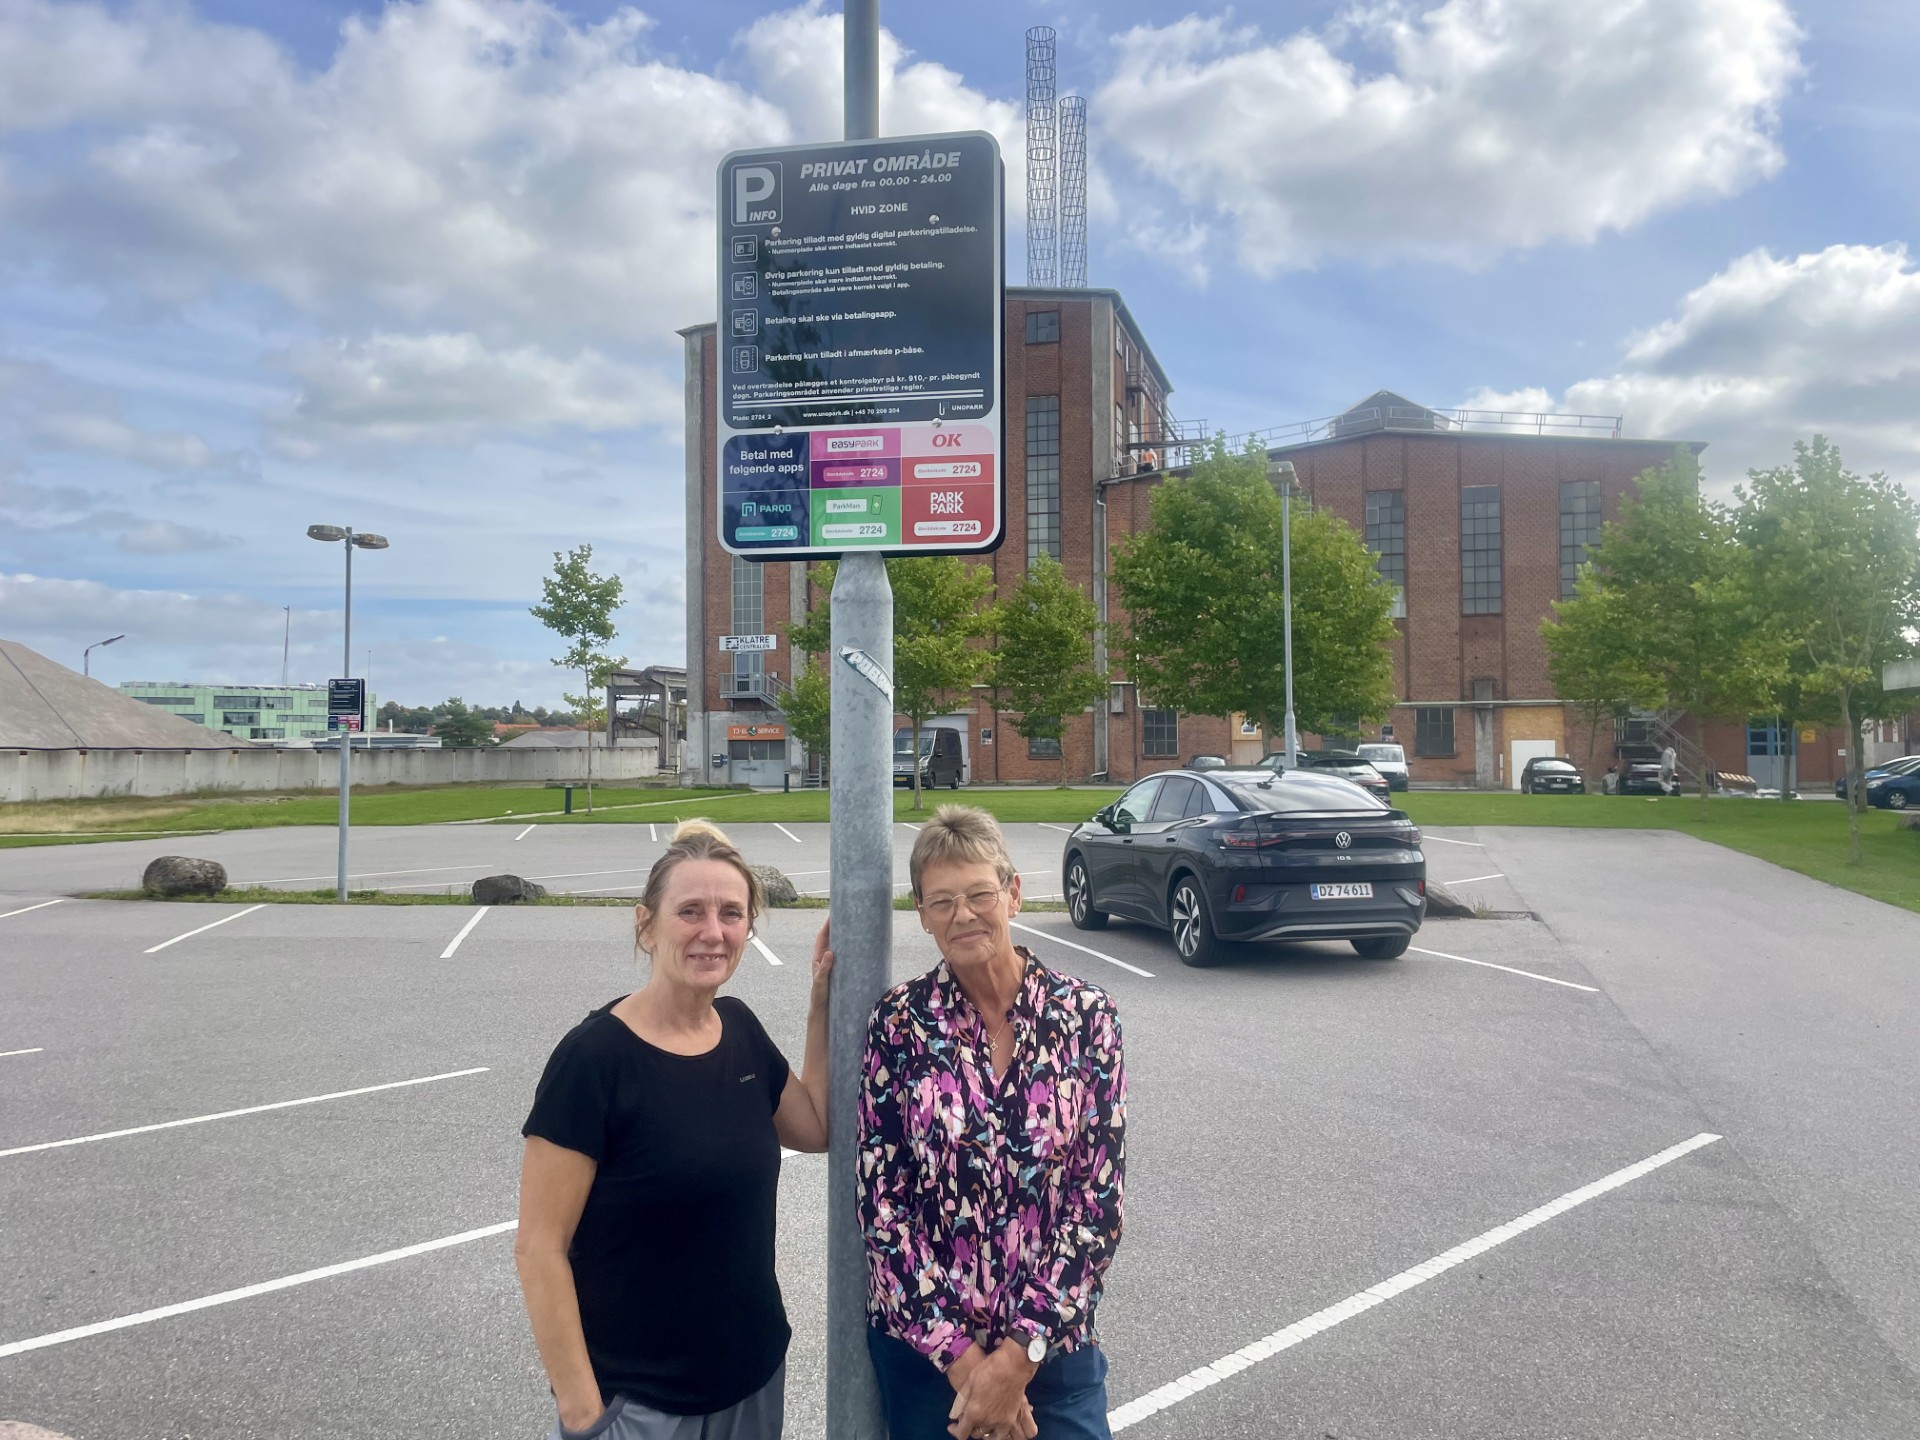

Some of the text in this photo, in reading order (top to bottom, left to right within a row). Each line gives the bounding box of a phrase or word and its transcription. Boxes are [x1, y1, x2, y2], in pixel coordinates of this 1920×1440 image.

[800, 148, 962, 179] PRIVAT OMRÅDE
[809, 183, 829, 192] Alle
[832, 180, 858, 191] dage
[861, 179, 876, 188] fra
[879, 176, 910, 187] 00.00
[920, 173, 952, 184] 24.00
[736, 167, 776, 222] P
[851, 203, 909, 216] HVID ZONE
[749, 210, 777, 222] INFO
[764, 226, 978, 246] Parkering tilladt med gyldig digital parkeringstilladelse.
[772, 246, 813, 255] Nummerplade
[764, 271, 785, 280] Øvrig
[787, 268, 823, 280] parkering
[842, 266, 865, 274] tilladt
[885, 263, 908, 272] gyldig
[910, 261, 944, 270] betaling.
[772, 279, 813, 287] Nummerplade
[765, 316, 796, 325] Betaling
[798, 315, 814, 323] skal
[816, 314, 829, 322] ske
[844, 310, 897, 320] betalingsapp.
[765, 354, 802, 362] Parkering
[820, 350, 843, 359] tilladt
[848, 348, 893, 357] afmærkede
[894, 346, 924, 356] p-båse.
[747, 382, 792, 390] overtrædelse
[795, 380, 828, 389] pålægges
[839, 377, 884, 385] kontrolgebyr
[886, 375, 895, 384] på
[908, 374, 927, 383] 910,-
[942, 372, 980, 381] påbegyndt
[754, 388, 819, 398] Parkeringsområdet
[932, 433, 963, 447] OK
[740, 449, 793, 460] Betal med
[730, 464, 804, 476] følgende apps
[860, 468, 884, 478] 2724
[952, 465, 976, 474] 2724
[930, 491, 964, 503] PARK
[930, 503, 964, 514] PARK
[771, 528, 794, 537] 2724
[859, 526, 883, 534] 2724
[952, 523, 976, 532] 2724
[1319, 884, 1370, 897] DZ 74 611
